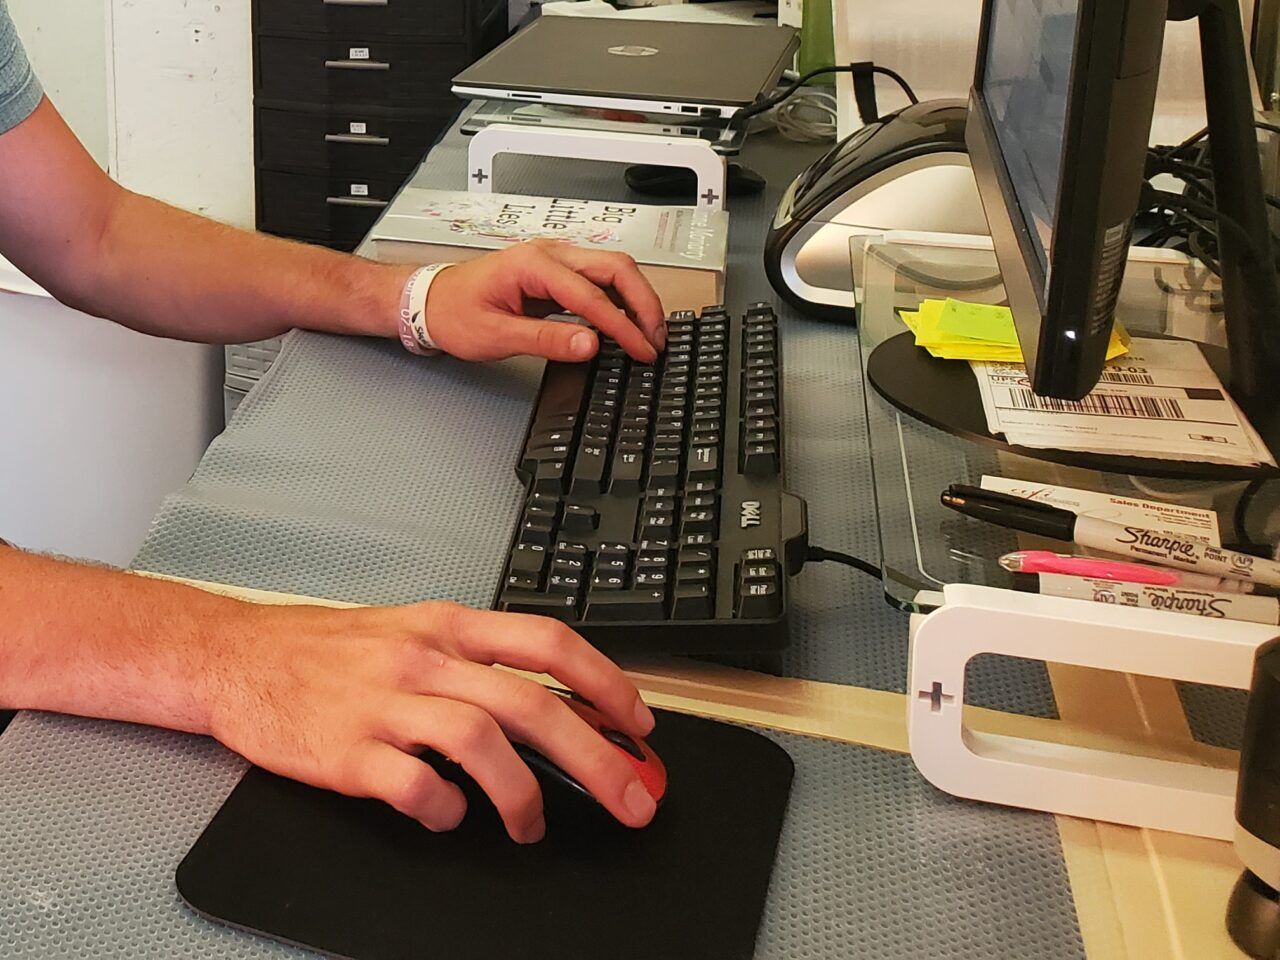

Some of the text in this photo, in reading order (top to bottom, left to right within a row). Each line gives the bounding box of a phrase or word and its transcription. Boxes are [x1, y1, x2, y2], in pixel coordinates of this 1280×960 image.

[496, 203, 537, 226] Lies
[542, 198, 588, 230] Little
[592, 205, 636, 224] Big
[741, 501, 760, 528] DELL
[1110, 497, 1210, 519] Sales Department
[1115, 526, 1195, 557] Sharpie
[1130, 545, 1167, 559] Permanent
[1204, 551, 1228, 563] POINT
[1150, 593, 1232, 618] Sharpie
